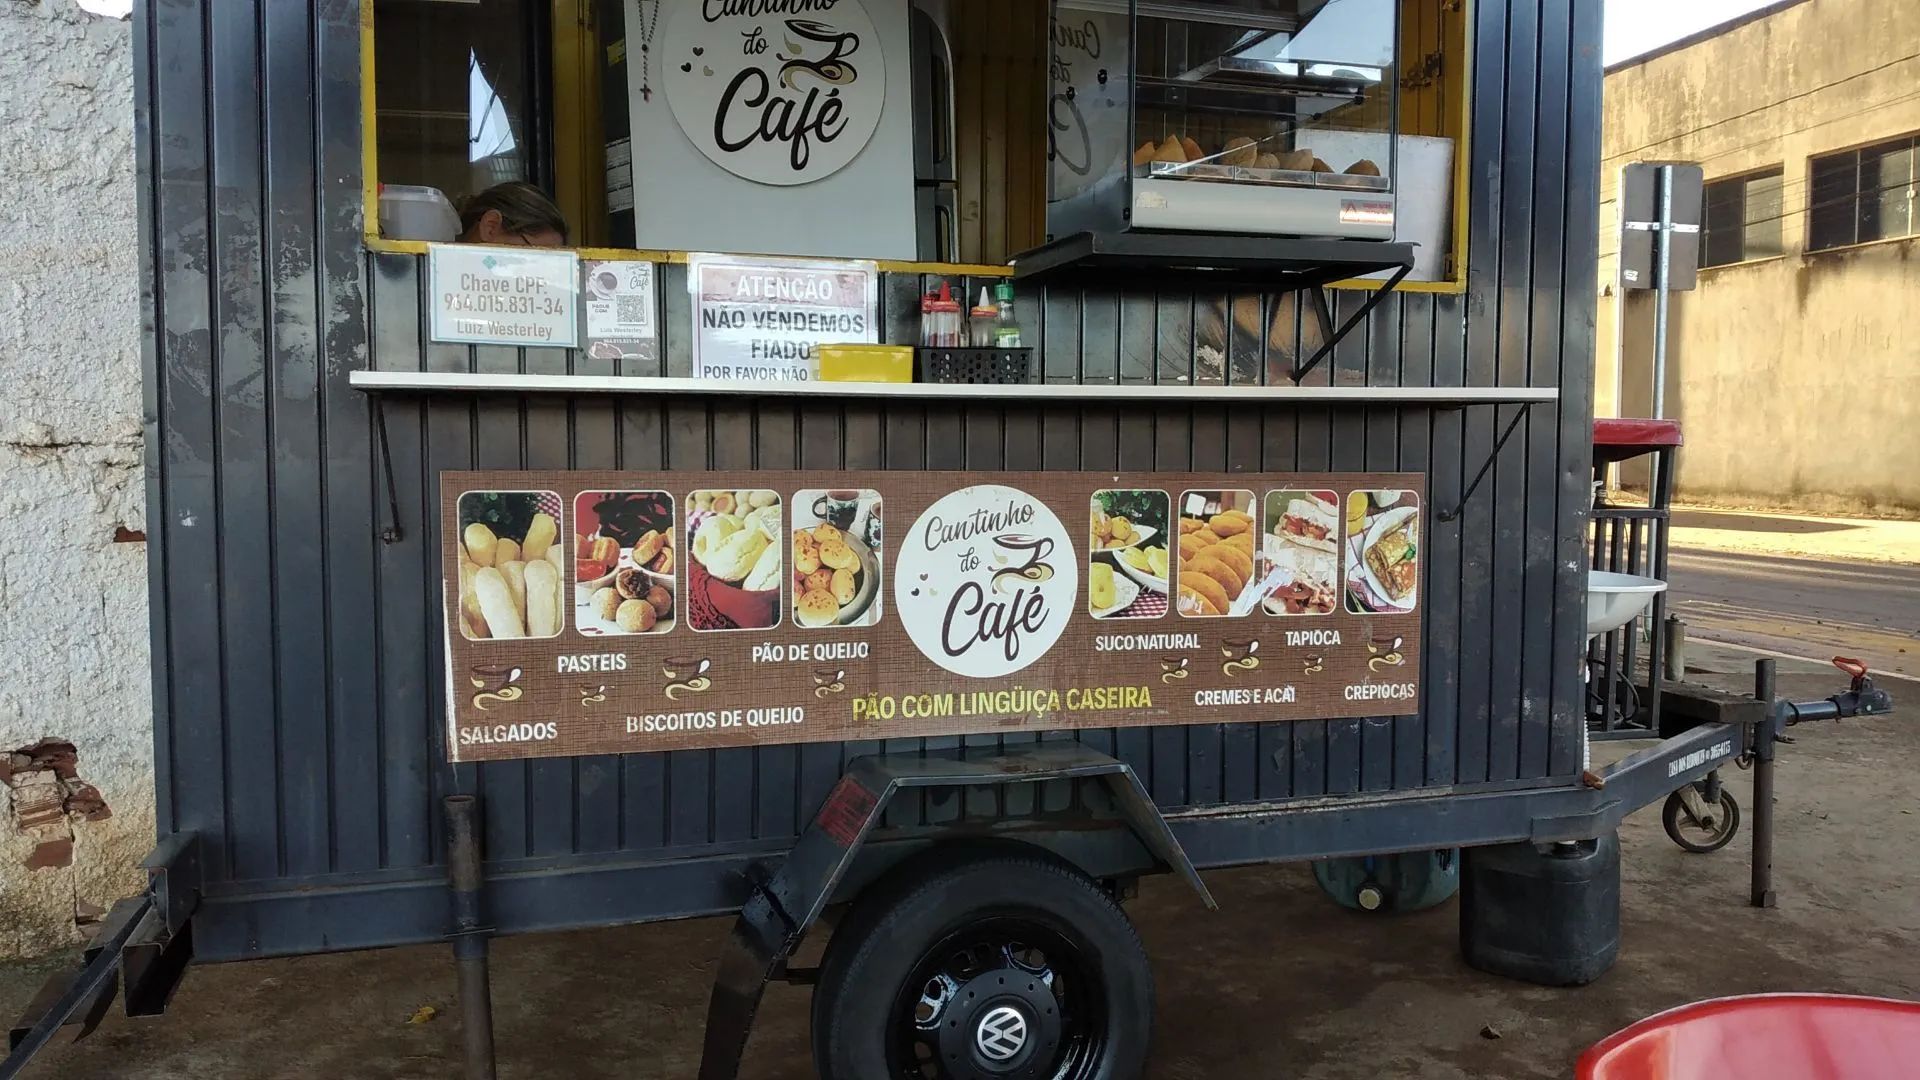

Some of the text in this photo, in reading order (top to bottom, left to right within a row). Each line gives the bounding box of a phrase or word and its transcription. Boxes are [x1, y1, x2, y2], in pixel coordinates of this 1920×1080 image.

[741, 26, 769, 55] do
[714, 66, 849, 171] Café
[461, 273, 548, 295] Chave CPF:
[736, 273, 833, 301] ATENÇÃO
[444, 293, 564, 315] 964.015.831-34
[703, 305, 864, 334] NÃO VENDEMOS
[488, 321, 552, 341] Westerley
[704, 365, 731, 379] POR
[735, 367, 777, 381] FAVOR
[782, 366, 808, 382] NÃO
[924, 500, 1036, 551] Cantinho
[957, 546, 981, 573] do
[941, 585, 1050, 661] Café
[1095, 633, 1201, 651] SUCO NATURAL
[1285, 630, 1341, 646] TAPIOCA
[557, 653, 627, 673] PASTEIS
[752, 641, 869, 663] PÃO DE QUEIJO
[1195, 689, 1250, 706] CREMES
[1253, 689, 1262, 704] E
[1345, 683, 1416, 700] CREPIOCAS
[852, 686, 1152, 721] PÃO COM LINGÜIÇA CASEIRA
[626, 706, 804, 733] BISCOITOS DE QUEIJO
[460, 722, 558, 745] SALGADOS
